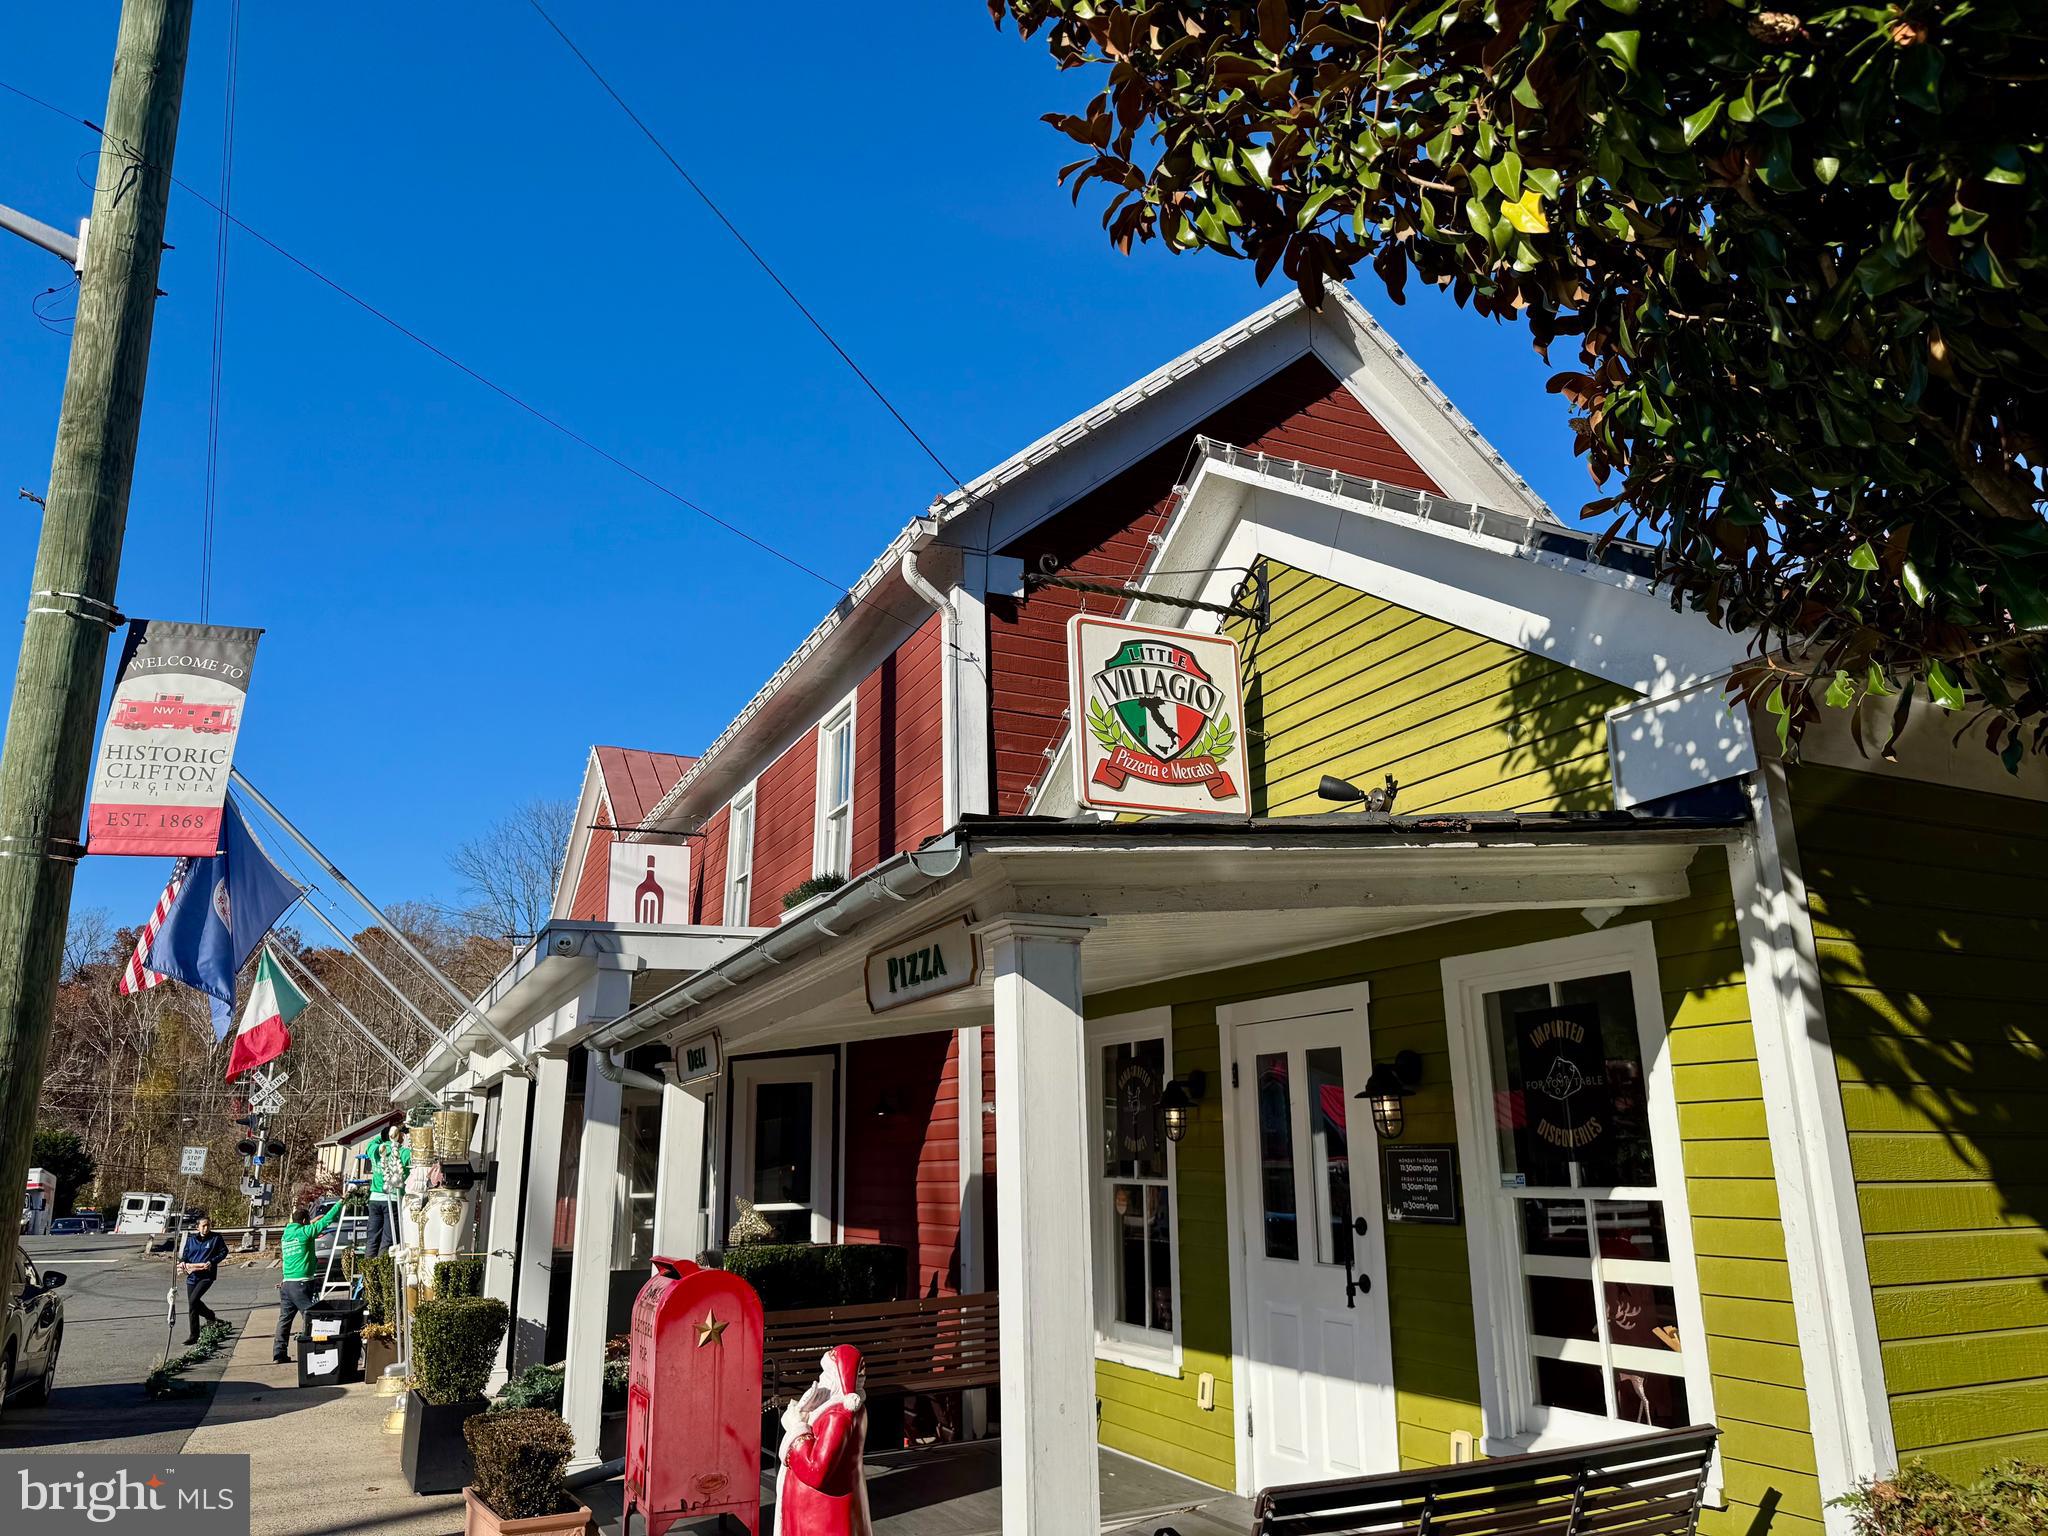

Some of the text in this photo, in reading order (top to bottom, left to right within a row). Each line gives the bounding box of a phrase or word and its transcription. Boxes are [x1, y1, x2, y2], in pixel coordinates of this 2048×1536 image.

[129, 655, 244, 679] WELCOME TO
[1127, 648, 1187, 669] LITTLE
[1099, 668, 1215, 711] VILLAGIO
[153, 706, 175, 715] NW
[105, 744, 226, 764] HISTORIC
[1115, 749, 1214, 779] Pizzeria e Mercato
[106, 763, 217, 782] CLIFTON
[104, 780, 214, 793] VIRGINIA
[106, 812, 205, 829] EST. 1868
[886, 944, 948, 993] PIZZA
[1528, 1019, 1585, 1048] IMPORTED
[687, 1046, 707, 1072] DELI
[252, 1074, 287, 1103] CROSSING
[254, 1073, 284, 1105] RAIL ROAD
[1526, 1080, 1544, 1090] FOR
[1574, 1075, 1604, 1086] TABLE
[1537, 1116, 1603, 1149] DISCOVERIES
